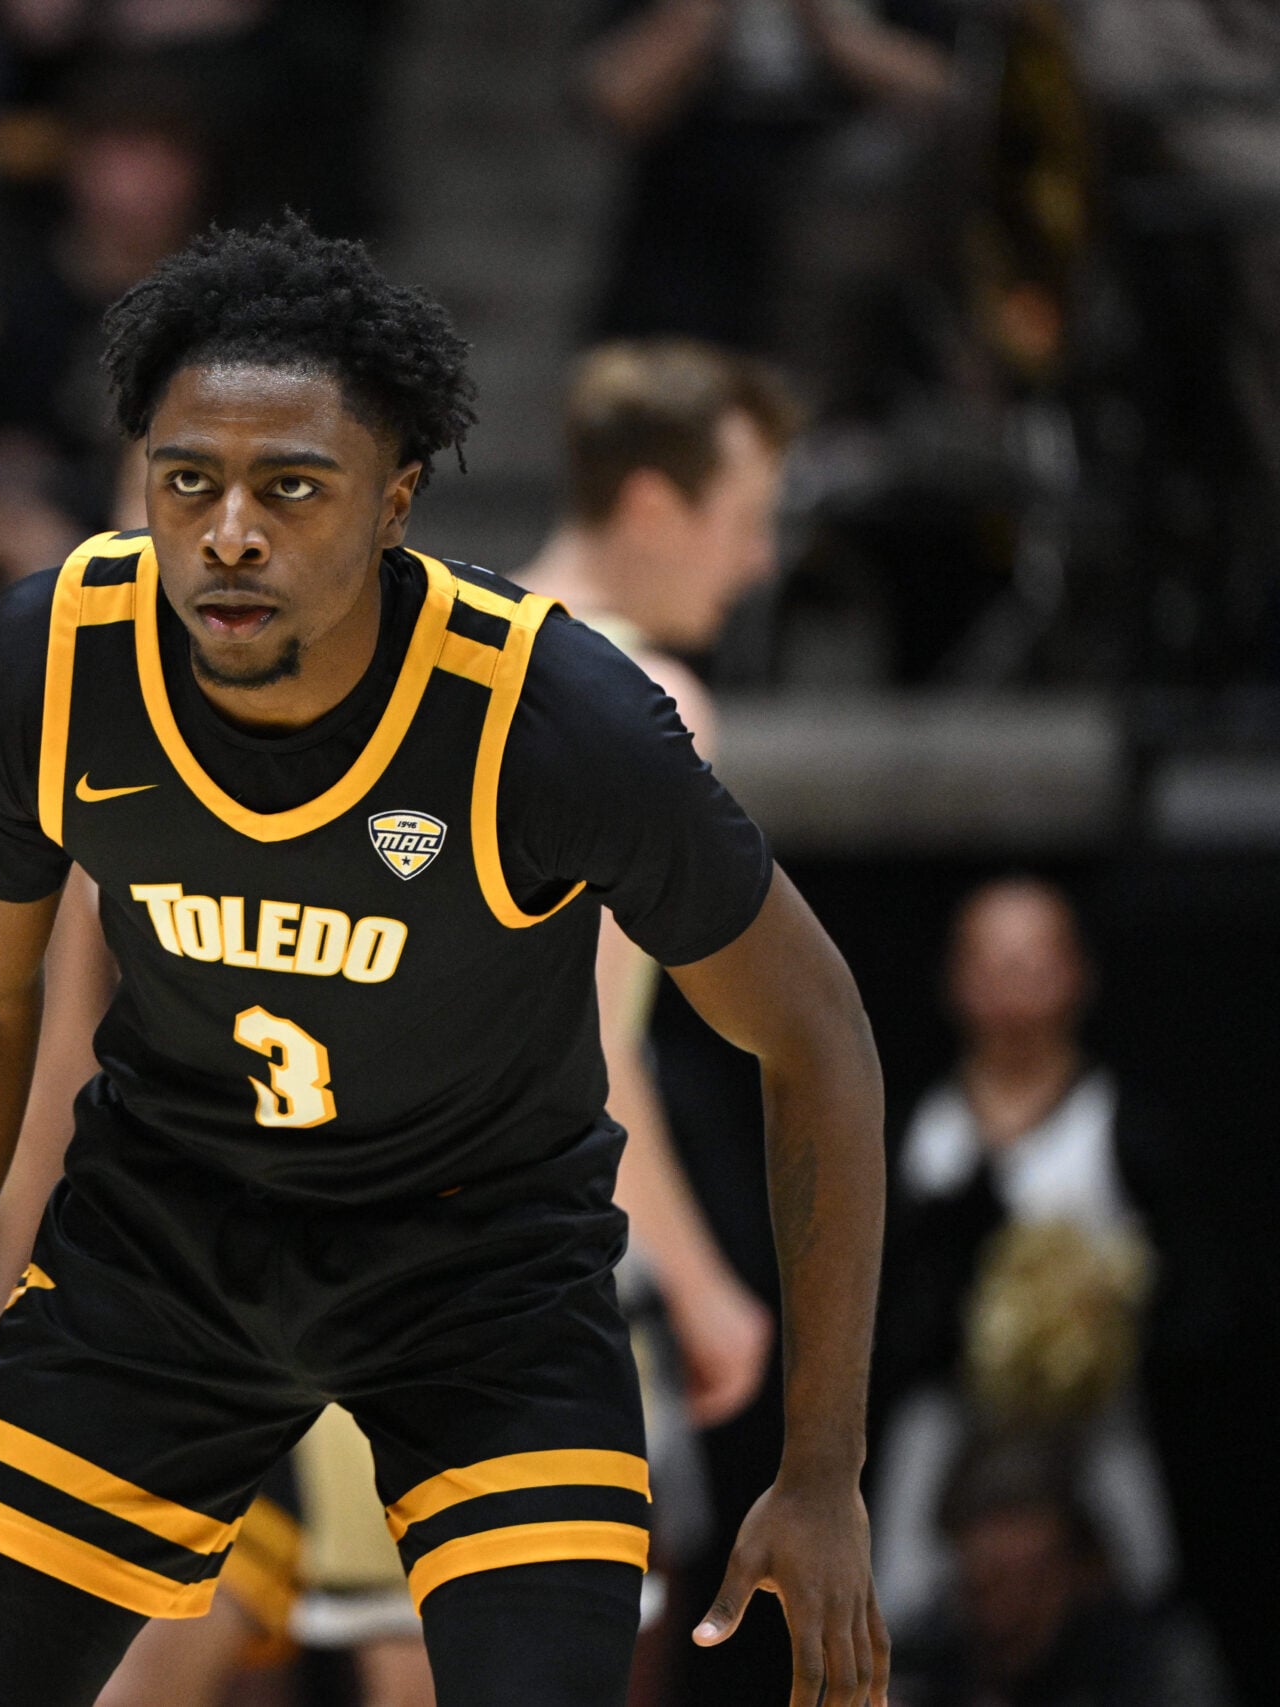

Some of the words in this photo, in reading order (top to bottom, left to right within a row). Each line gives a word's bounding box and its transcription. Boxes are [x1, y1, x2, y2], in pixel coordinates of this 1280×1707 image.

[376, 832, 440, 853] MAC
[397, 821, 418, 829] 1946
[130, 883, 408, 984] TOLEDO
[232, 1004, 337, 1129] 3
